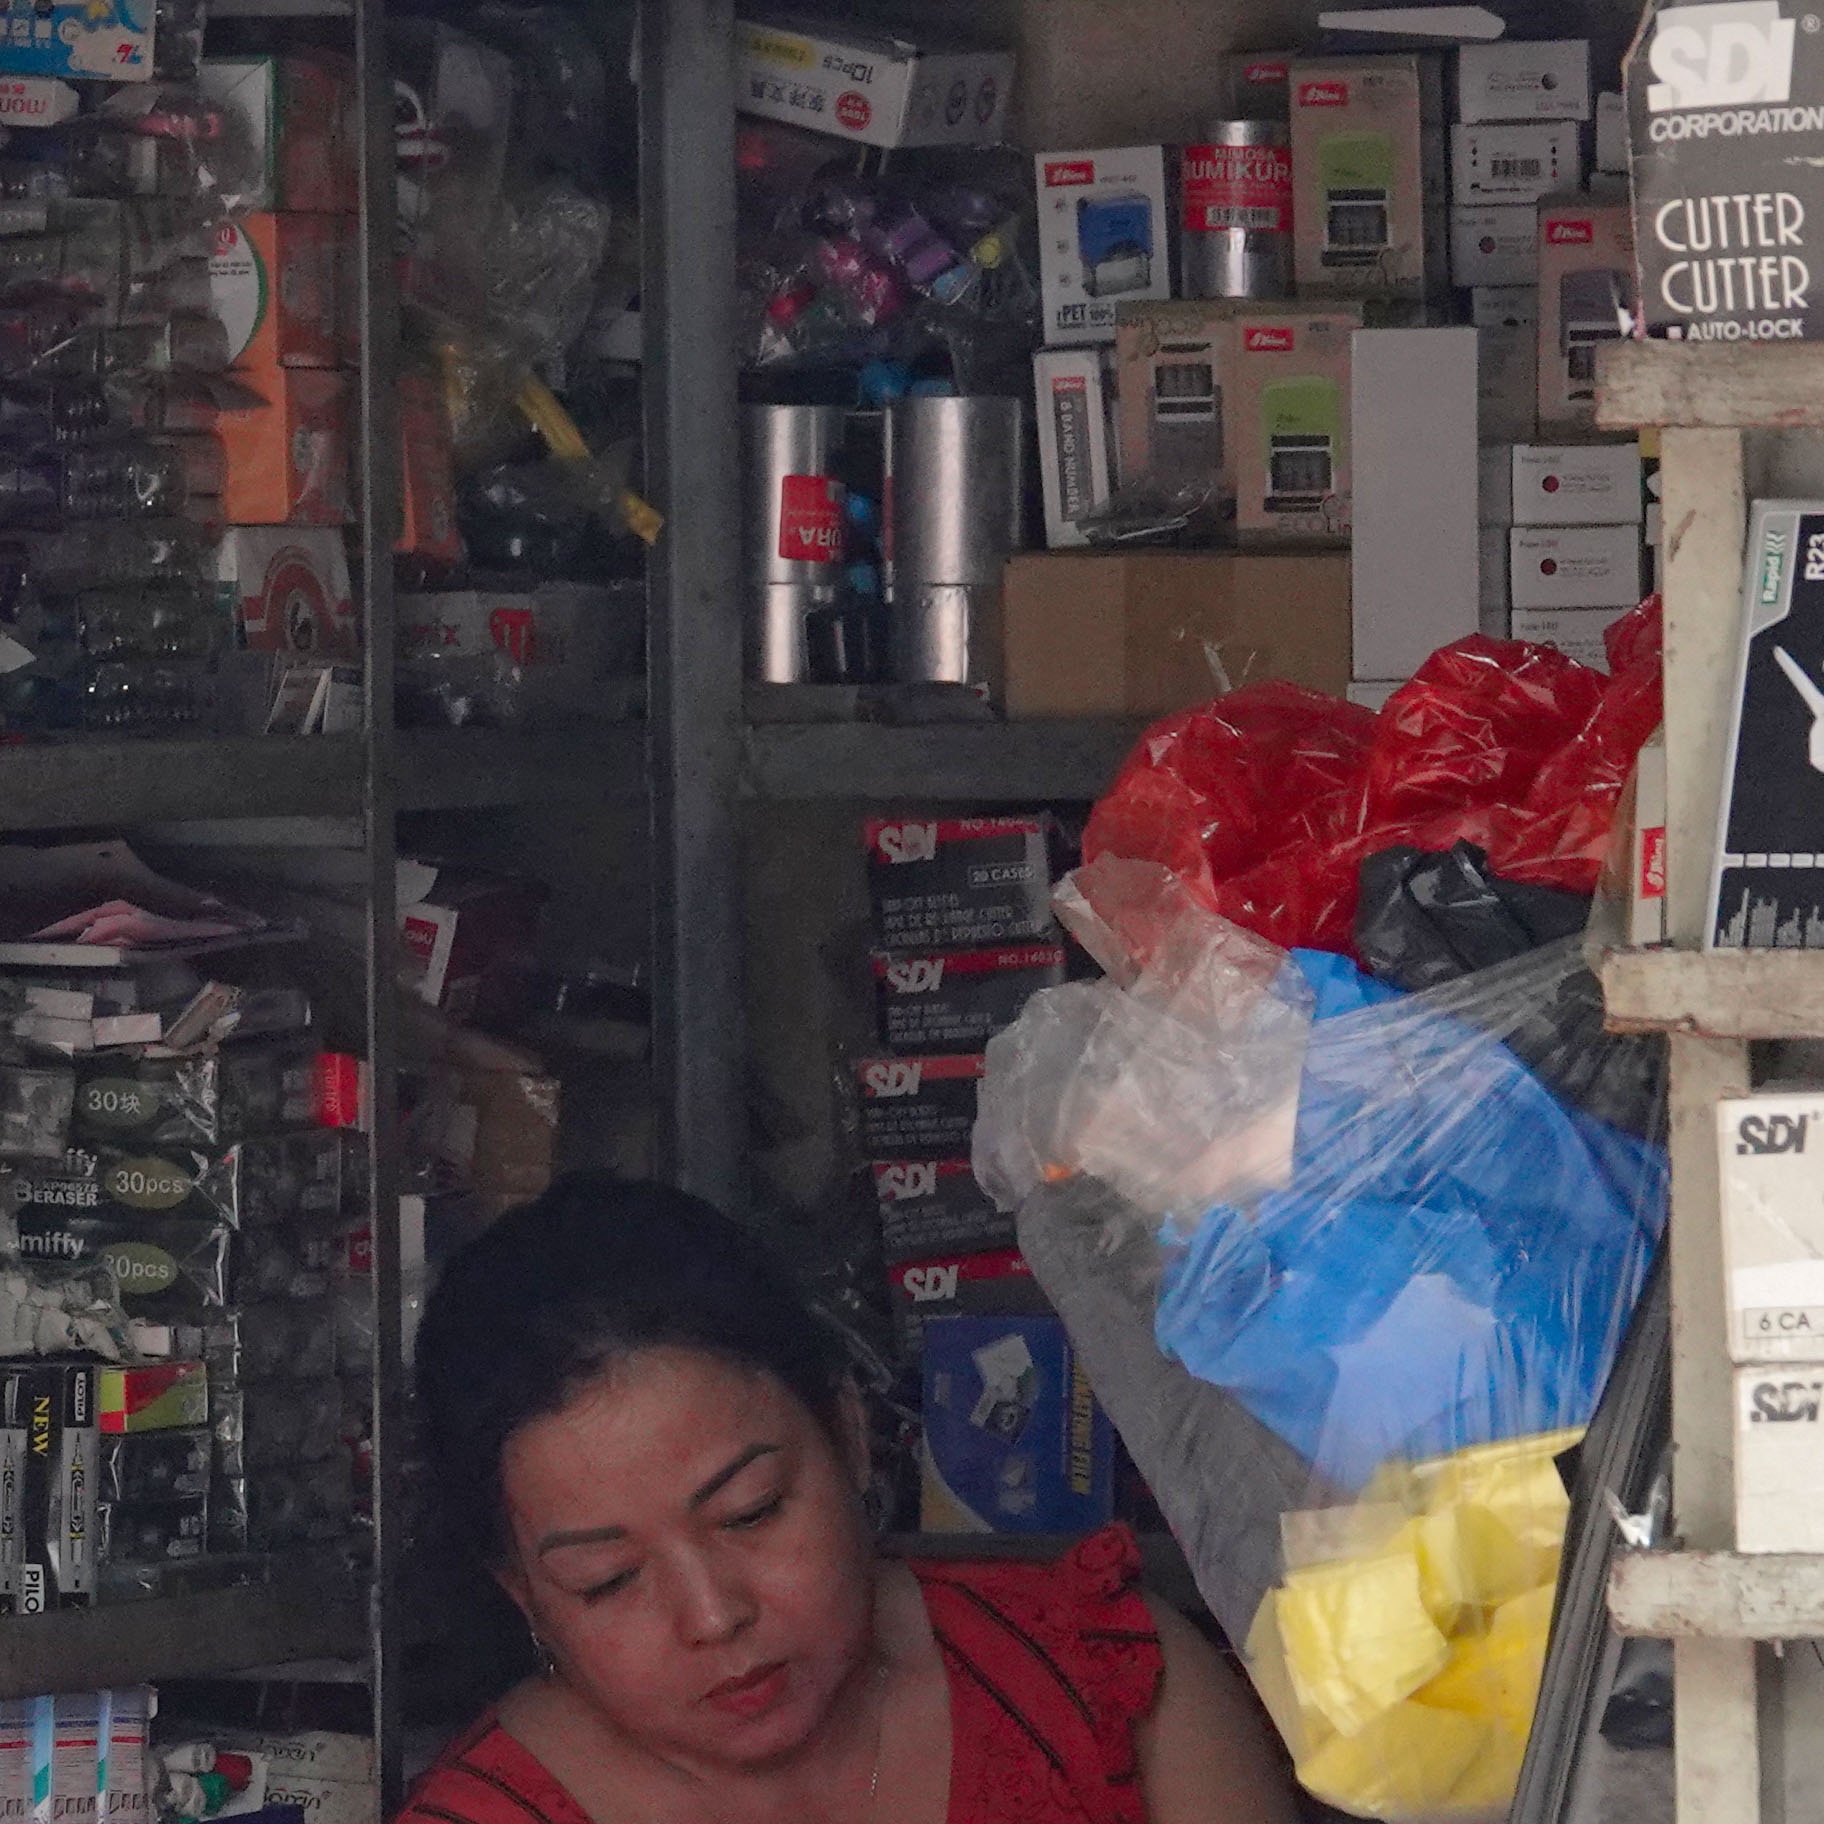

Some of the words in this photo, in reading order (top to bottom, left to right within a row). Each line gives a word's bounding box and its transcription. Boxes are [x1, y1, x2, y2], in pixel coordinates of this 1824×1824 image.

[1646, 0, 1797, 110] SDI
[1648, 105, 1824, 143] CORPORATION
[1654, 196, 1804, 253] CUTTER
[1659, 255, 1810, 314] CUTTER
[1686, 320, 1804, 341] AUTO-LOCK
[1736, 1114, 1808, 1155] SDI
[19, 1228, 85, 1260] miffy
[33, 1394, 51, 1457] NEW
